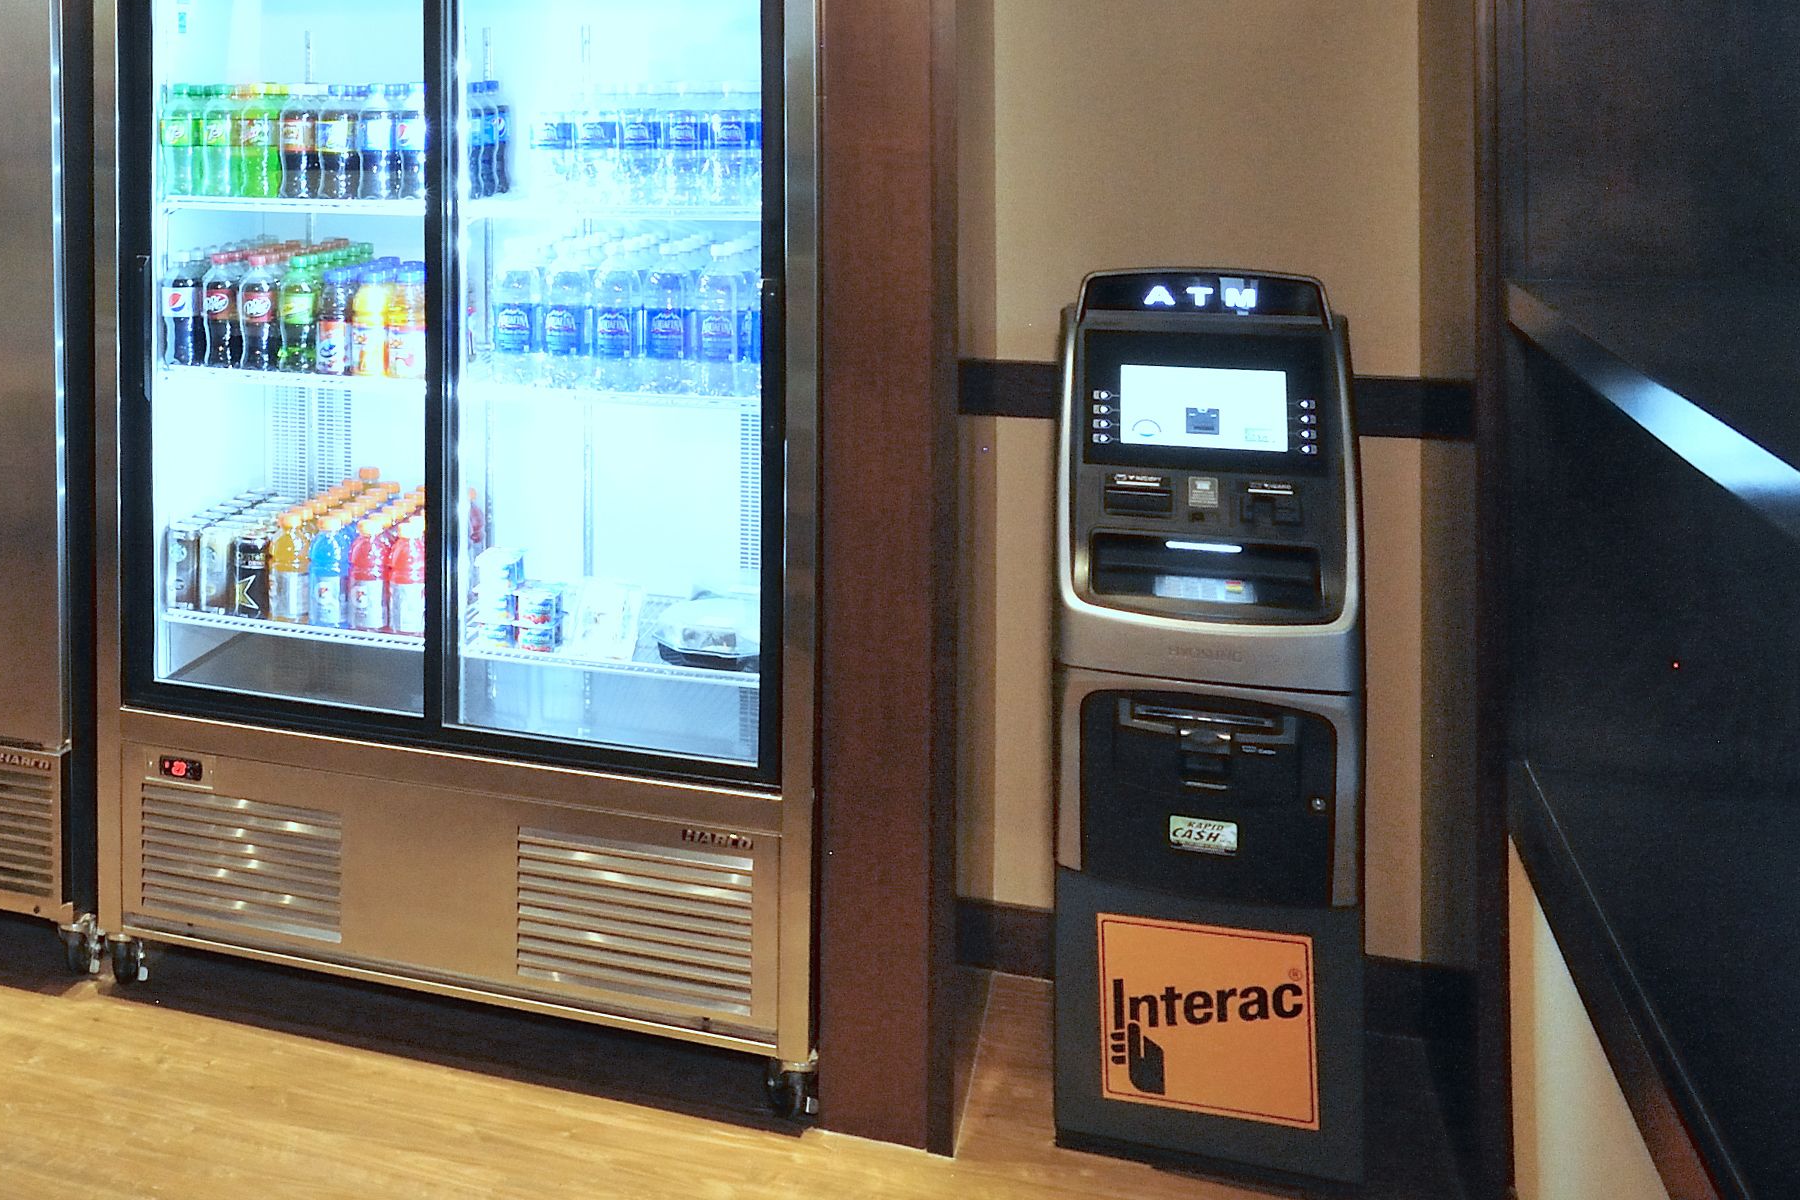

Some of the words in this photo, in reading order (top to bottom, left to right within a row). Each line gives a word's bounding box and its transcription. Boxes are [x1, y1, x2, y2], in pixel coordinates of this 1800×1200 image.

[1143, 285, 1257, 308] ATM
[1172, 827, 1220, 842] CASH
[1112, 978, 1303, 1031] Interac
